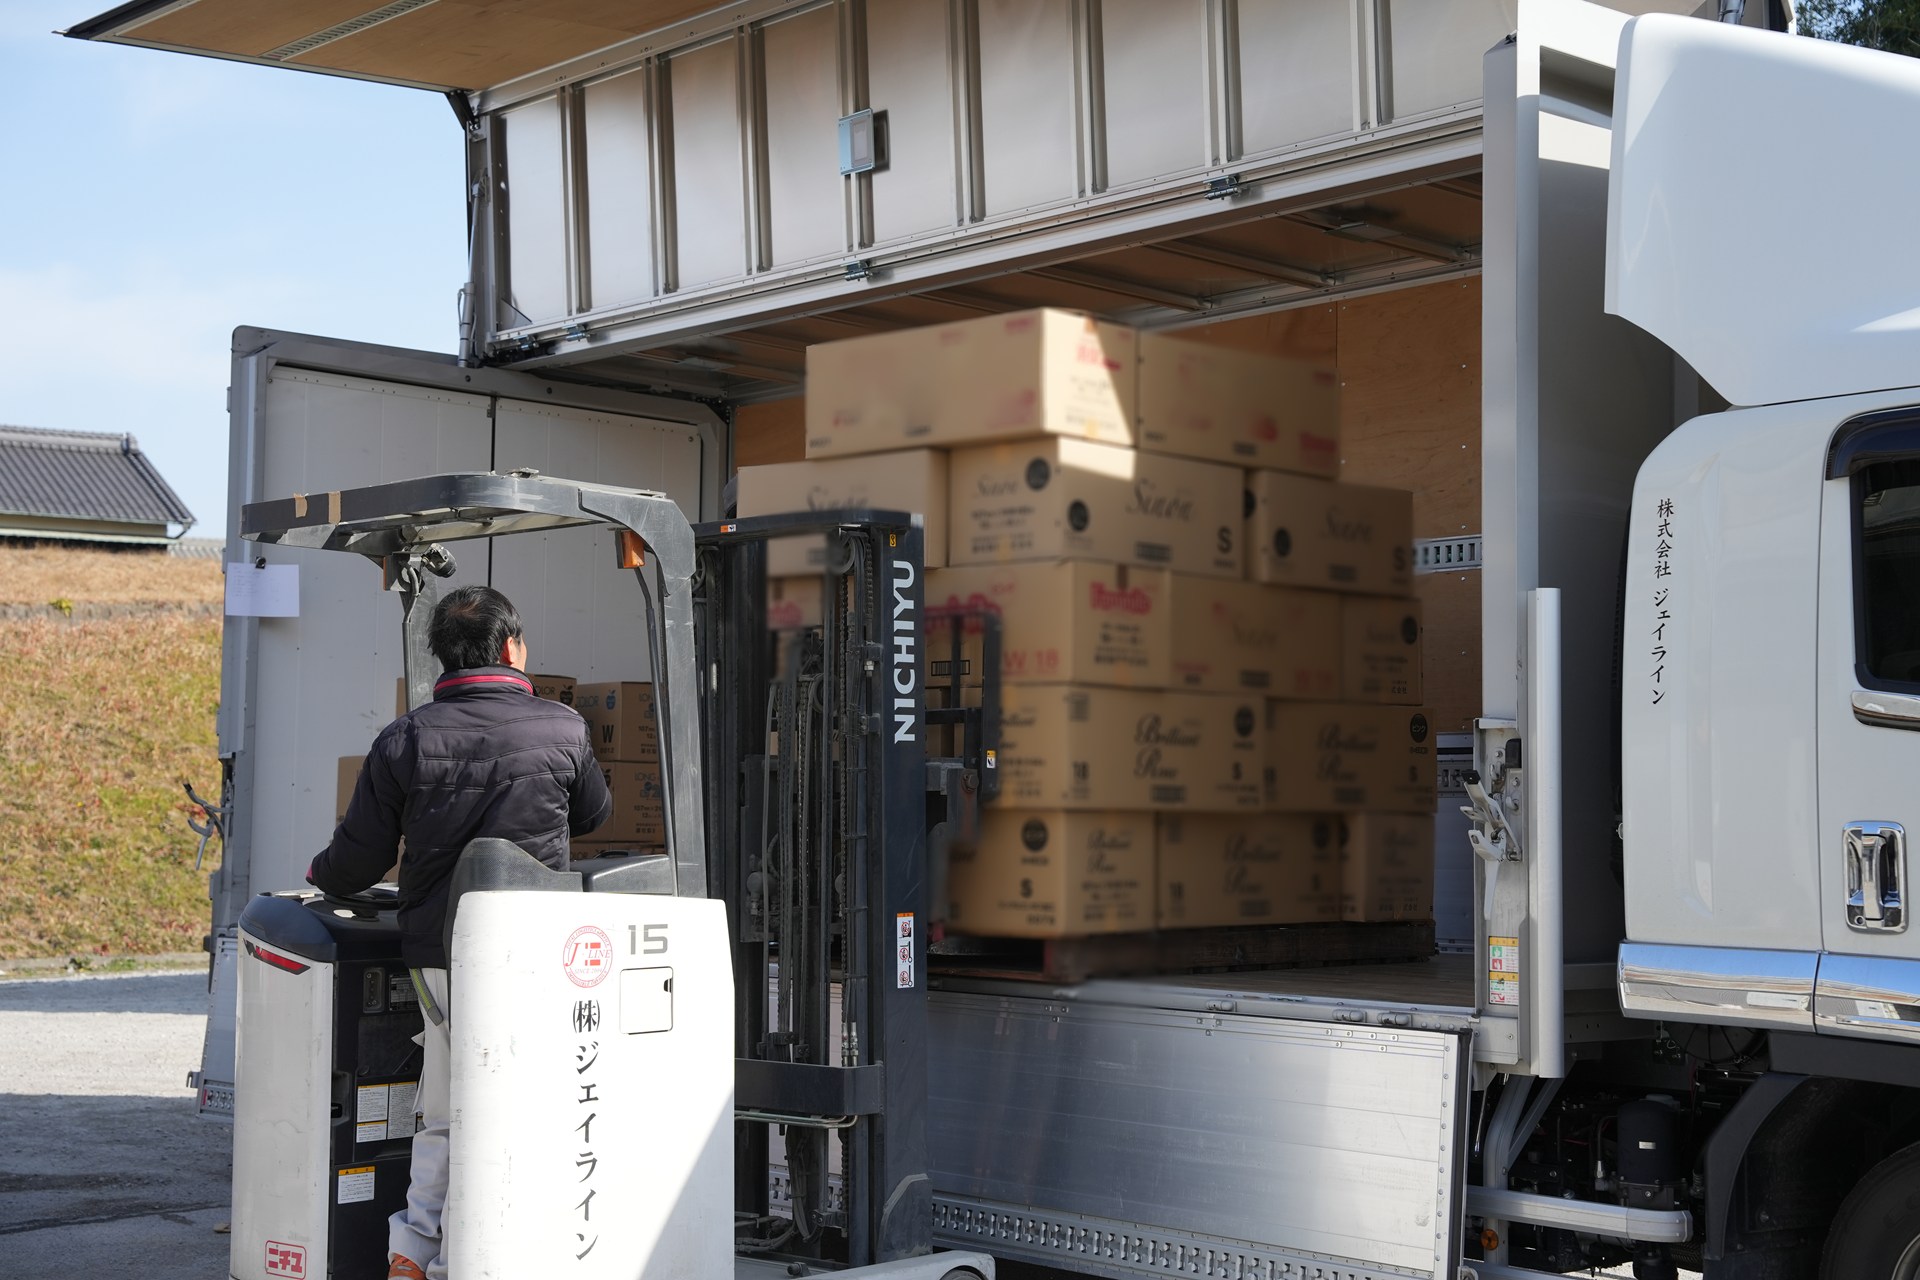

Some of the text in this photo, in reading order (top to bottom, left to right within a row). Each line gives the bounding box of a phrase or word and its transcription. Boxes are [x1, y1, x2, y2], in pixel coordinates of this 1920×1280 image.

[1217, 526, 1233, 554] S
[1650, 498, 1674, 705] 株式会社 ジェイライン
[893, 560, 916, 744] NICHIYU
[602, 724, 614, 744] W
[628, 923, 668, 955] 15
[564, 942, 611, 967] J LINE
